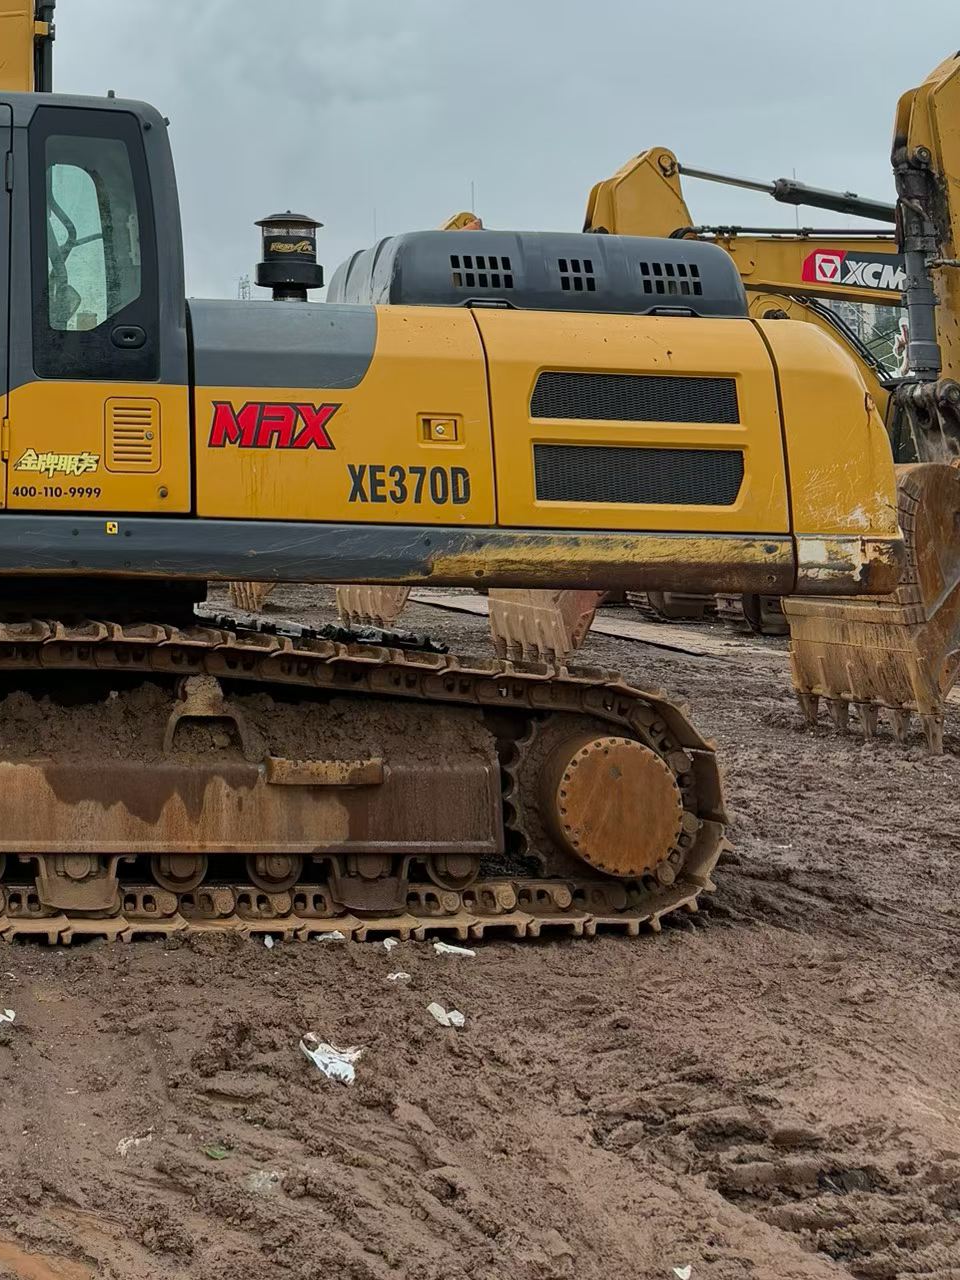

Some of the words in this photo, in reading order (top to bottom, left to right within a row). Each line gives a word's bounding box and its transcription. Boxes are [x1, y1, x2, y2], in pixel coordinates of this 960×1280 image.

[841, 259, 907, 290] XCM
[208, 401, 342, 451] MAX
[13, 448, 101, 479] 金牌服务
[12, 486, 102, 498] 400-110-9999
[347, 463, 471, 505] XE370D
